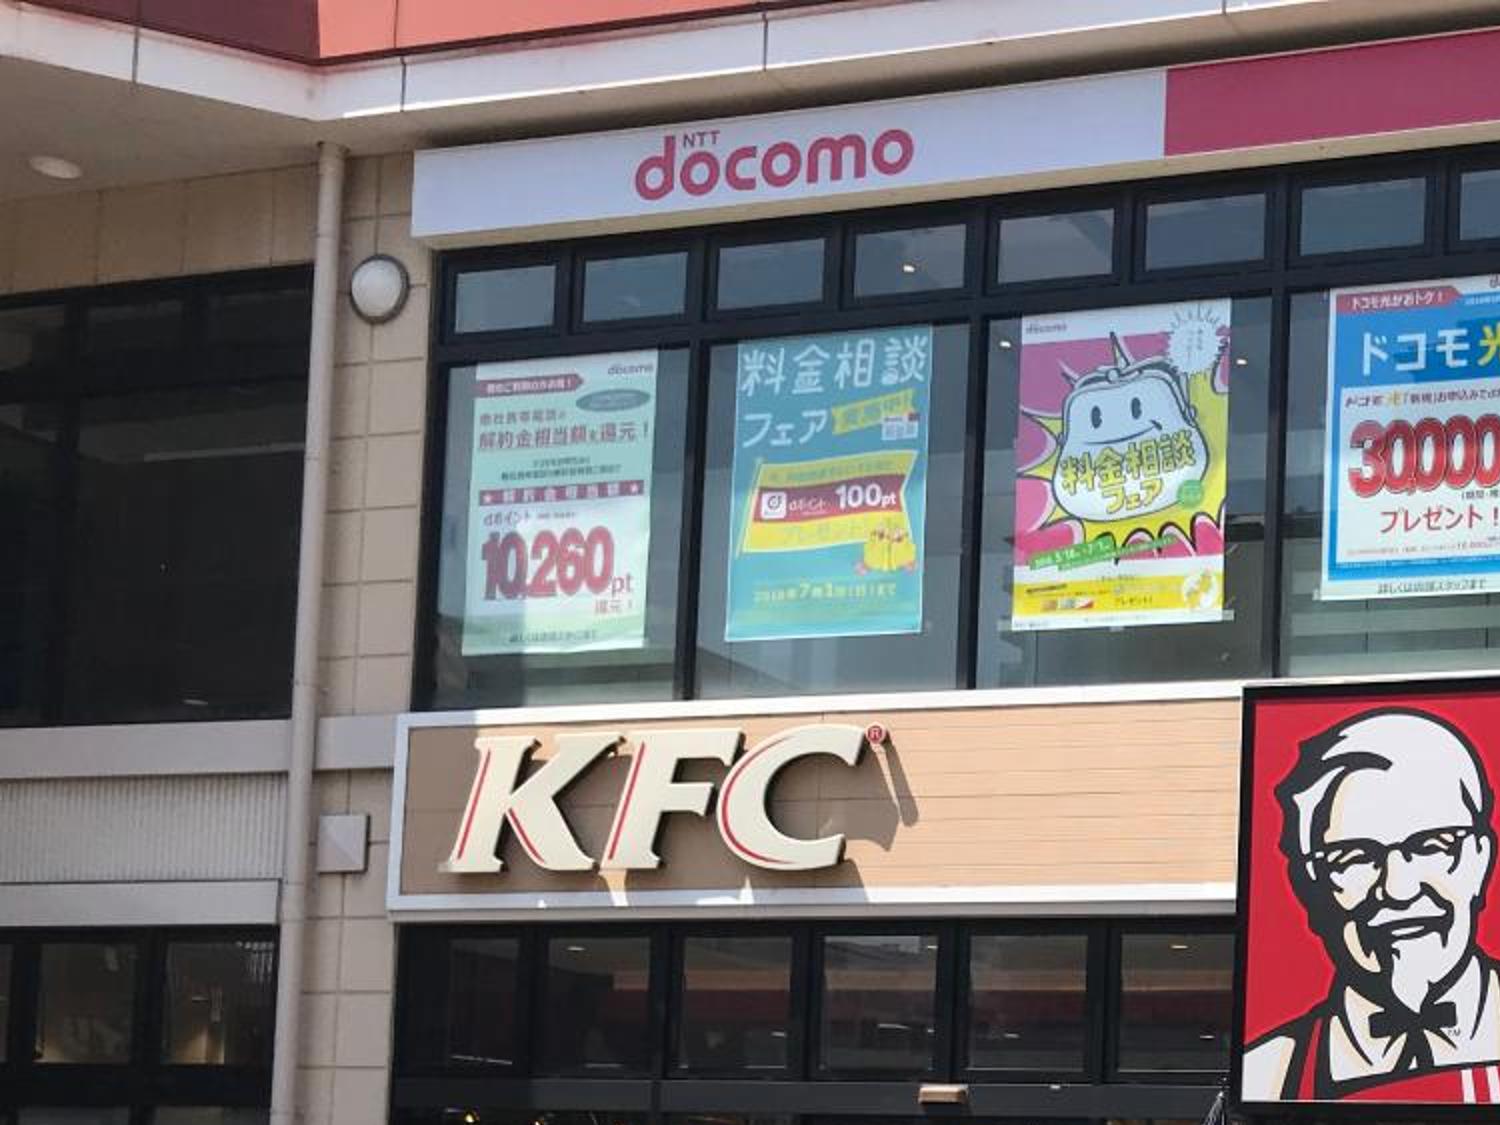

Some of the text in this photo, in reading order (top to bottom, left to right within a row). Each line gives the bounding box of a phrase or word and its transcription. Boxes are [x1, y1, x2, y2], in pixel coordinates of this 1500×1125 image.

[634, 129, 915, 201] docomo
[682, 130, 721, 149] NTT
[741, 334, 928, 397] 料金相談
[742, 408, 828, 448] フェア
[1060, 428, 1197, 496] 料金相談
[1102, 478, 1164, 515] フェア
[438, 724, 866, 874] KFC
